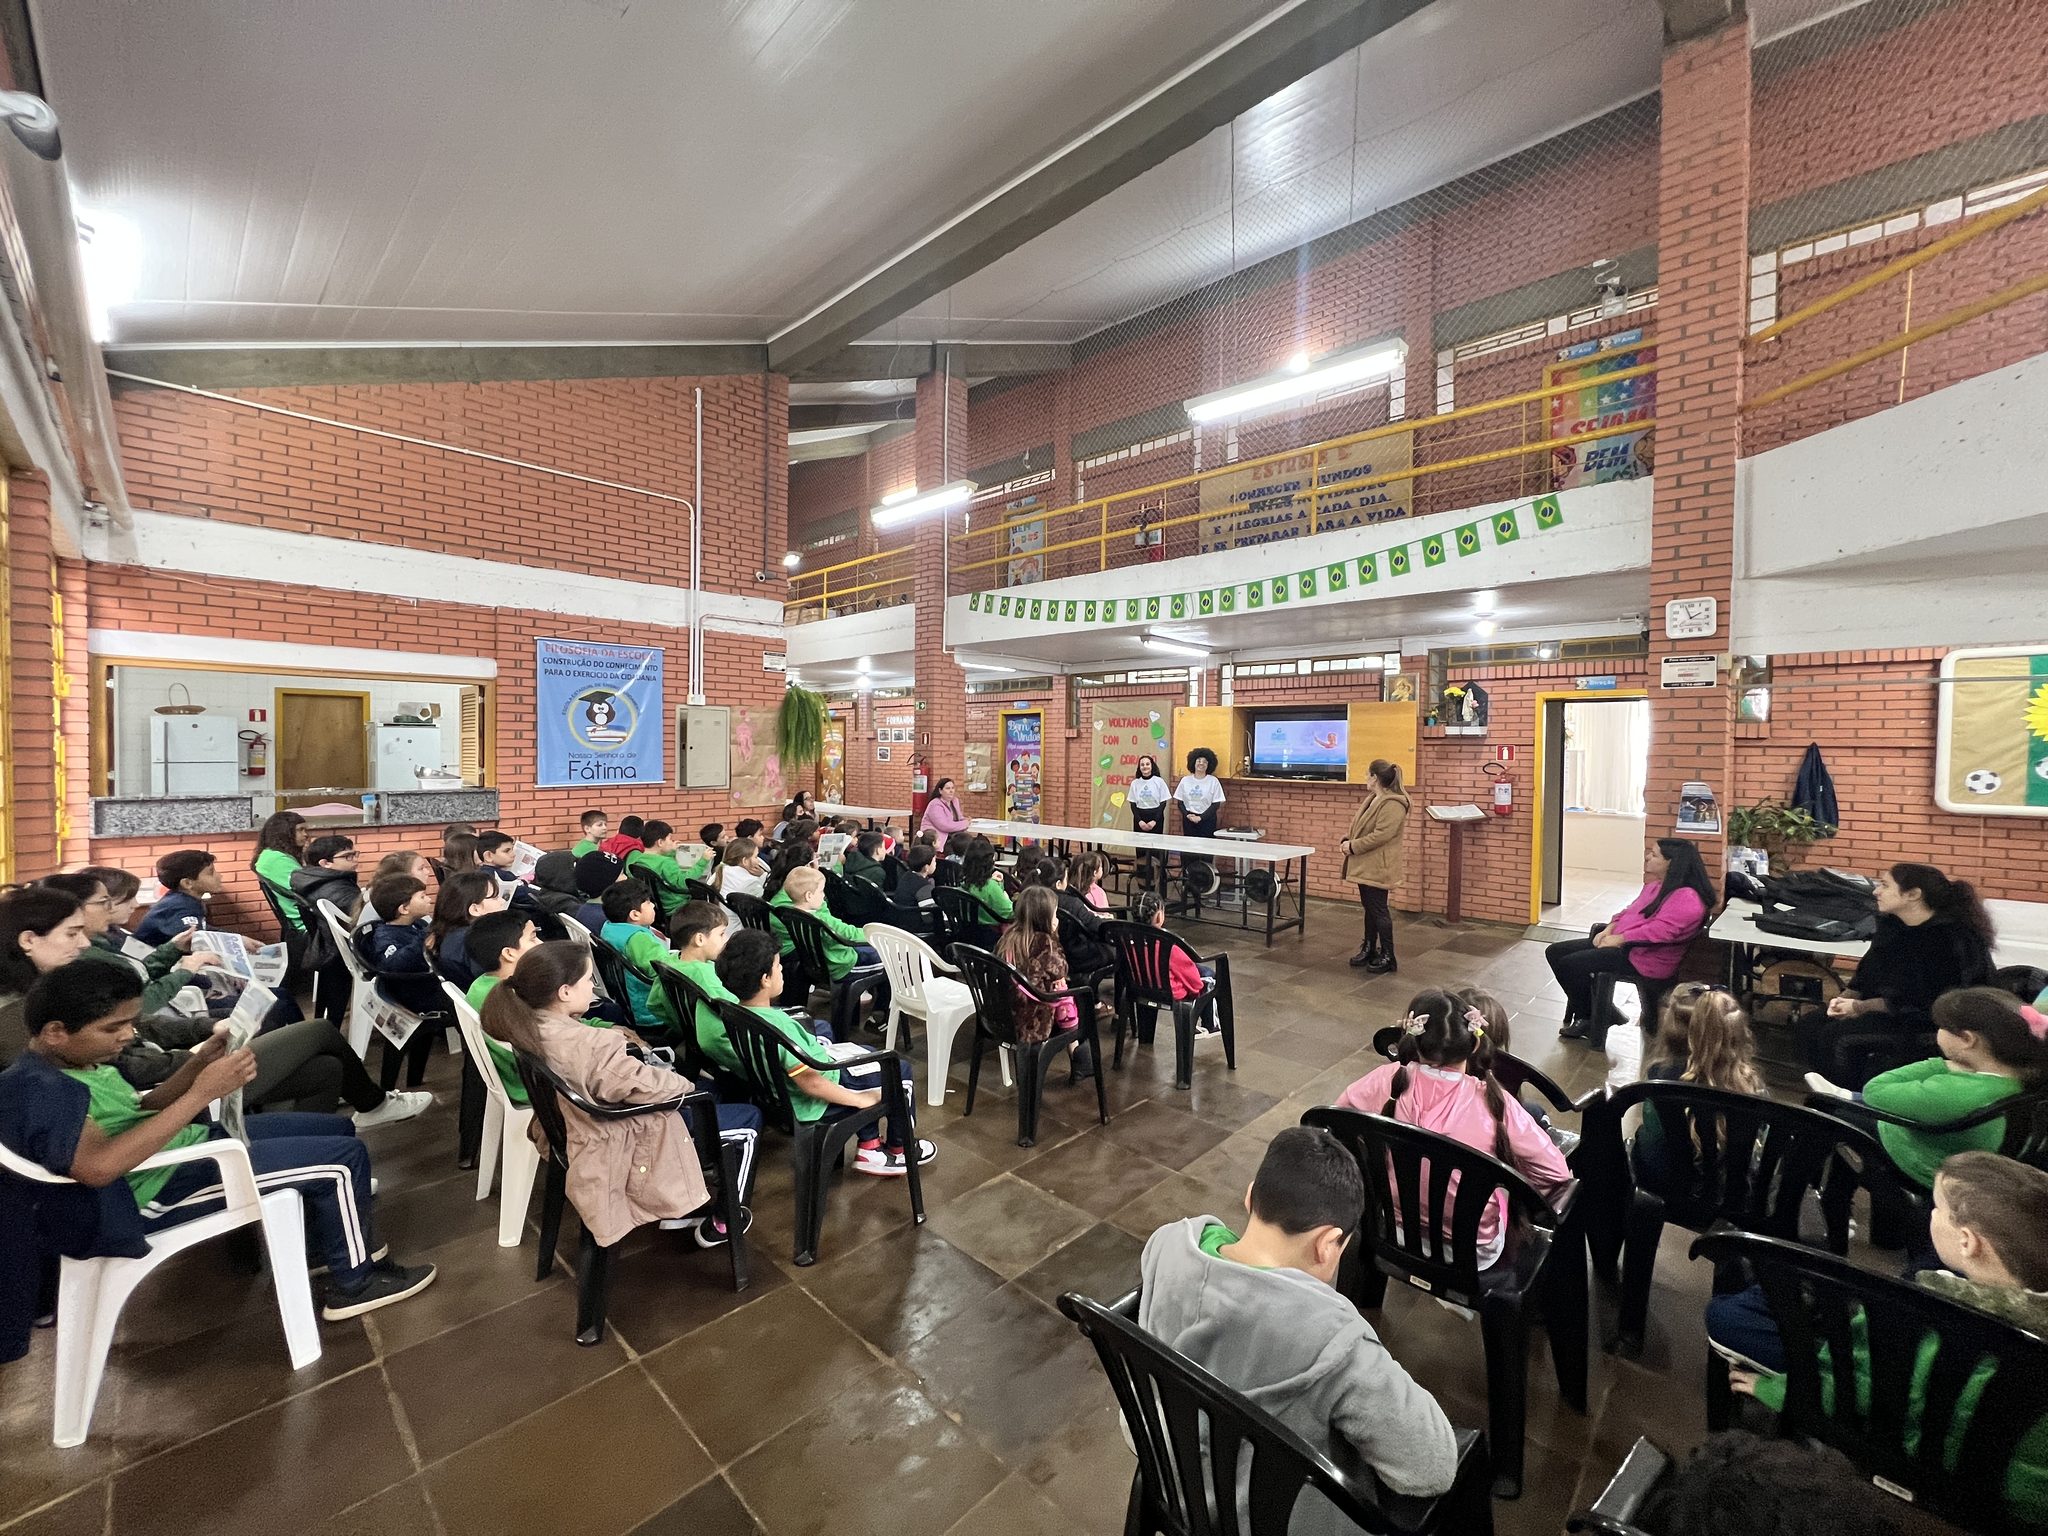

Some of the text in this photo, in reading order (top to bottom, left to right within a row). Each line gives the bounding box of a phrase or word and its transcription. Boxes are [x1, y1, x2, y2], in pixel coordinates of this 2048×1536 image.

[1583, 443, 1630, 473] BEM
[1213, 525, 1222, 535] E
[1298, 509, 1307, 520] A
[1316, 500, 1353, 515] ADA
[1201, 544, 1209, 555] E
[1350, 514, 1362, 526] A
[1366, 505, 1406, 523] VIDA
[545, 643, 598, 656] FILOSOFIA
[601, 649, 615, 657] DA
[542, 656, 658, 672] CONSTRUÇÃO DO CONHECIMNTO
[544, 668, 564, 676] PARA
[565, 669, 571, 677] O
[1108, 717, 1149, 728] VOLTAMOS
[568, 760, 637, 780] Fátima
